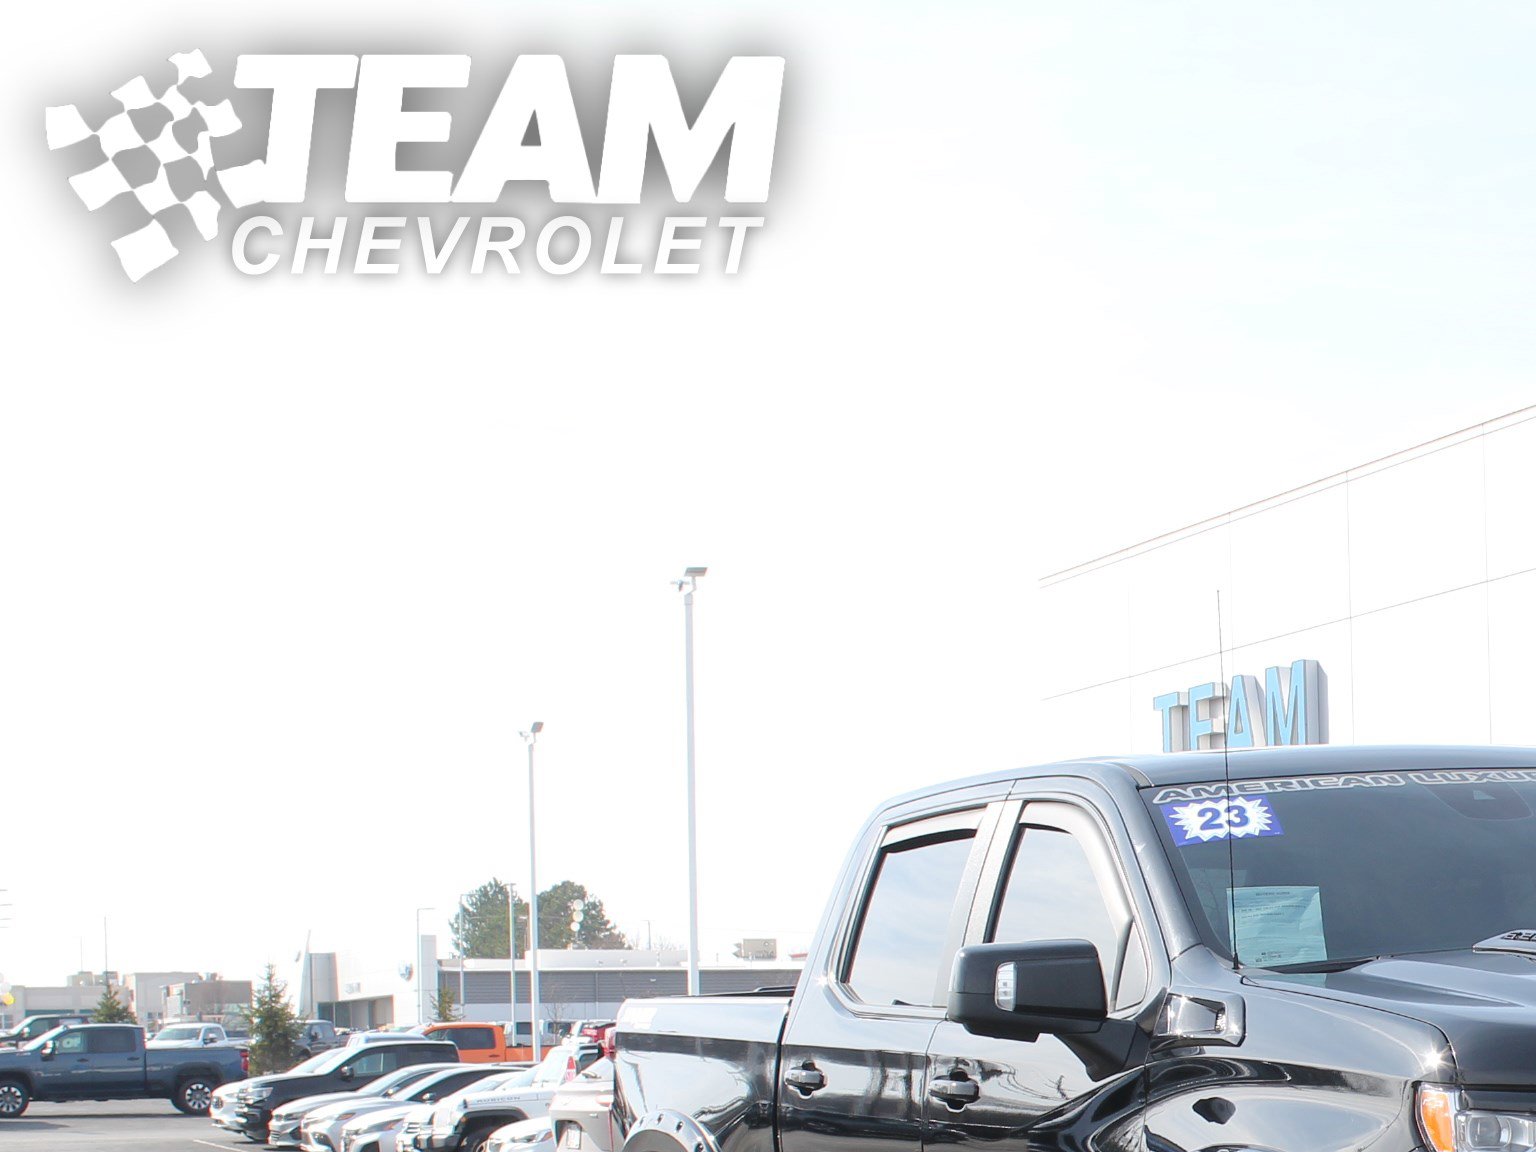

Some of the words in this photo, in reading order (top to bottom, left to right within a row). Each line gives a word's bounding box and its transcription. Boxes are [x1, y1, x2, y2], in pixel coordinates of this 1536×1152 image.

[1153, 659, 1318, 752] TEAM
[1152, 772, 1406, 804] AMERICAN
[1197, 804, 1250, 830] 23
